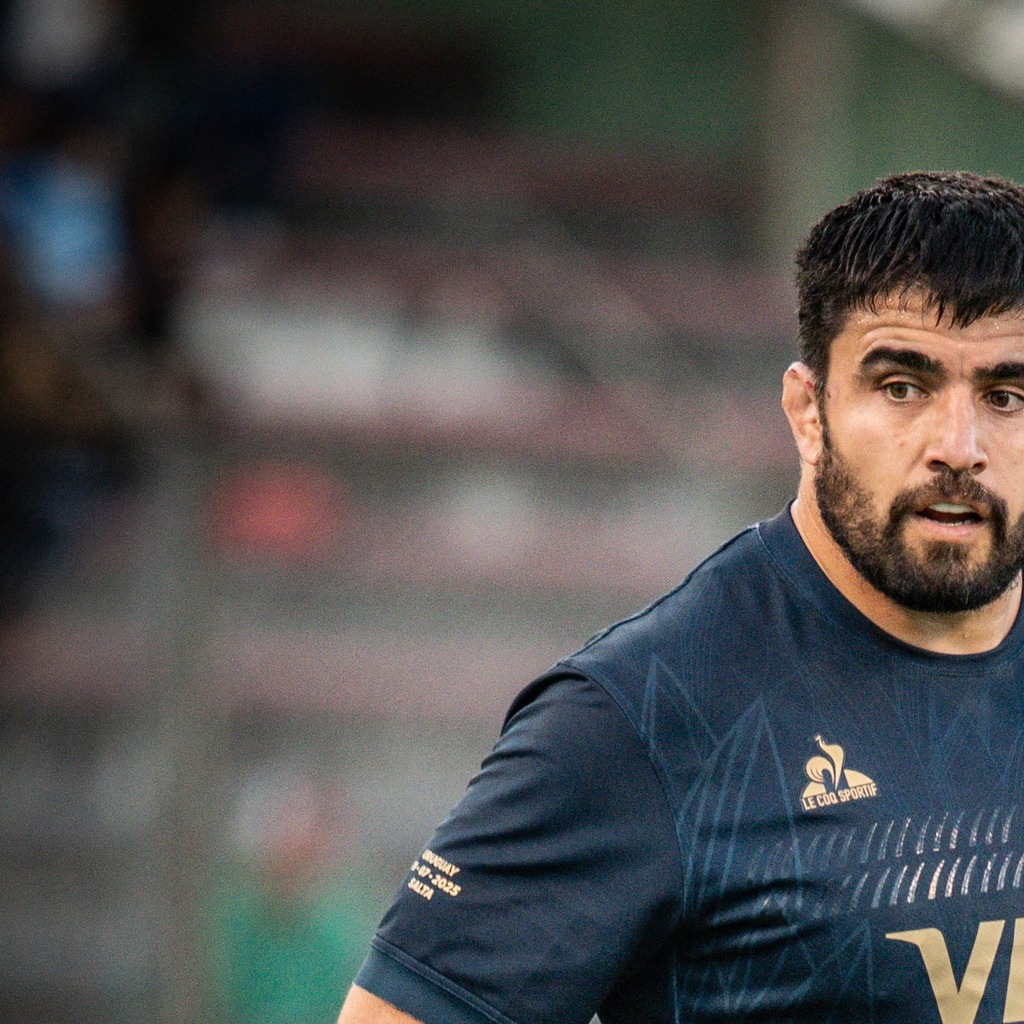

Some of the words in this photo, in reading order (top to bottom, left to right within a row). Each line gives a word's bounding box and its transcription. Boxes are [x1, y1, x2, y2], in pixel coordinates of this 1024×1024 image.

[802, 797, 817, 811] LE
[816, 792, 838, 807] COQ
[837, 783, 878, 802] SPORTIF
[408, 877, 435, 901] SALTA
